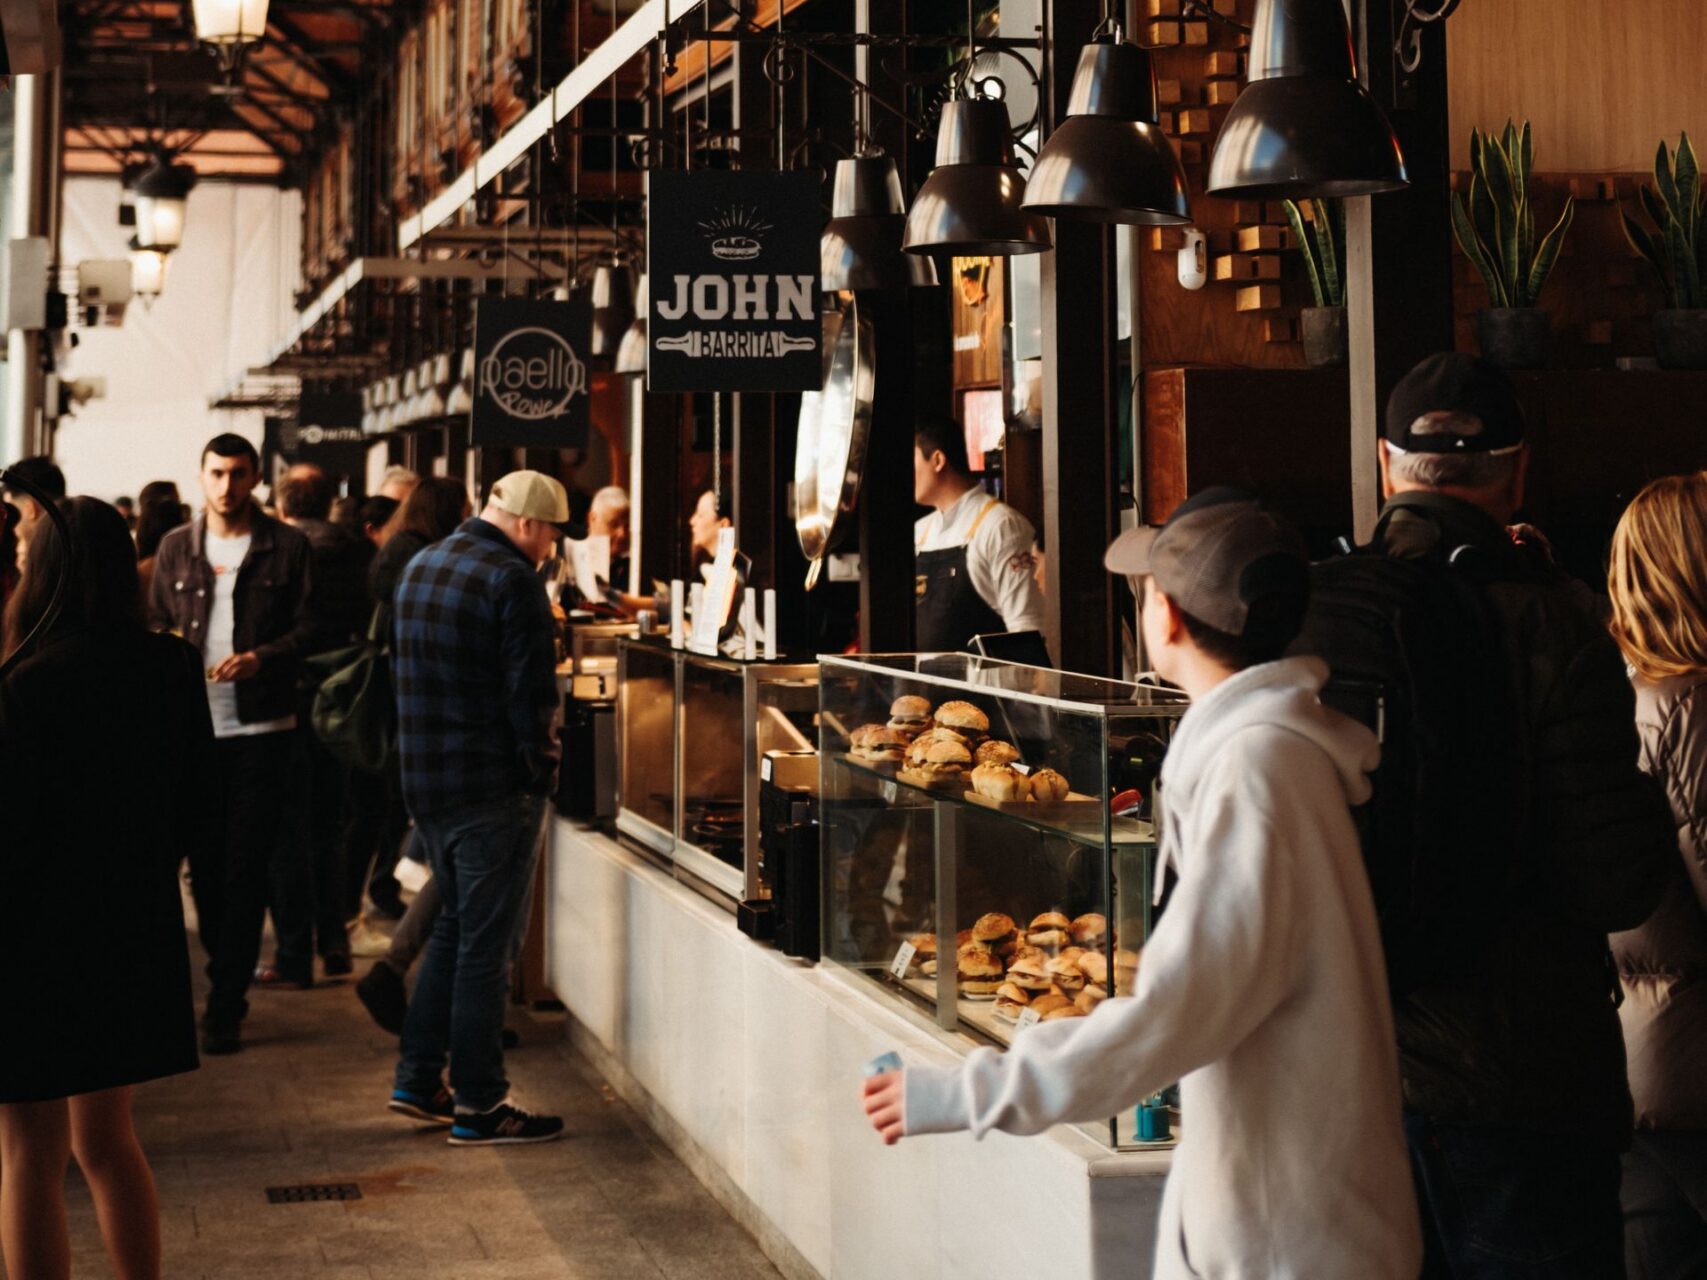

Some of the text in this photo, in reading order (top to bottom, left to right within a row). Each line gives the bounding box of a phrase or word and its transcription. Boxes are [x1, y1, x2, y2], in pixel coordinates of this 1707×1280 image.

[656, 274, 815, 320] JOHN
[701, 331, 776, 357] BARRITA
[479, 348, 588, 398] paella
